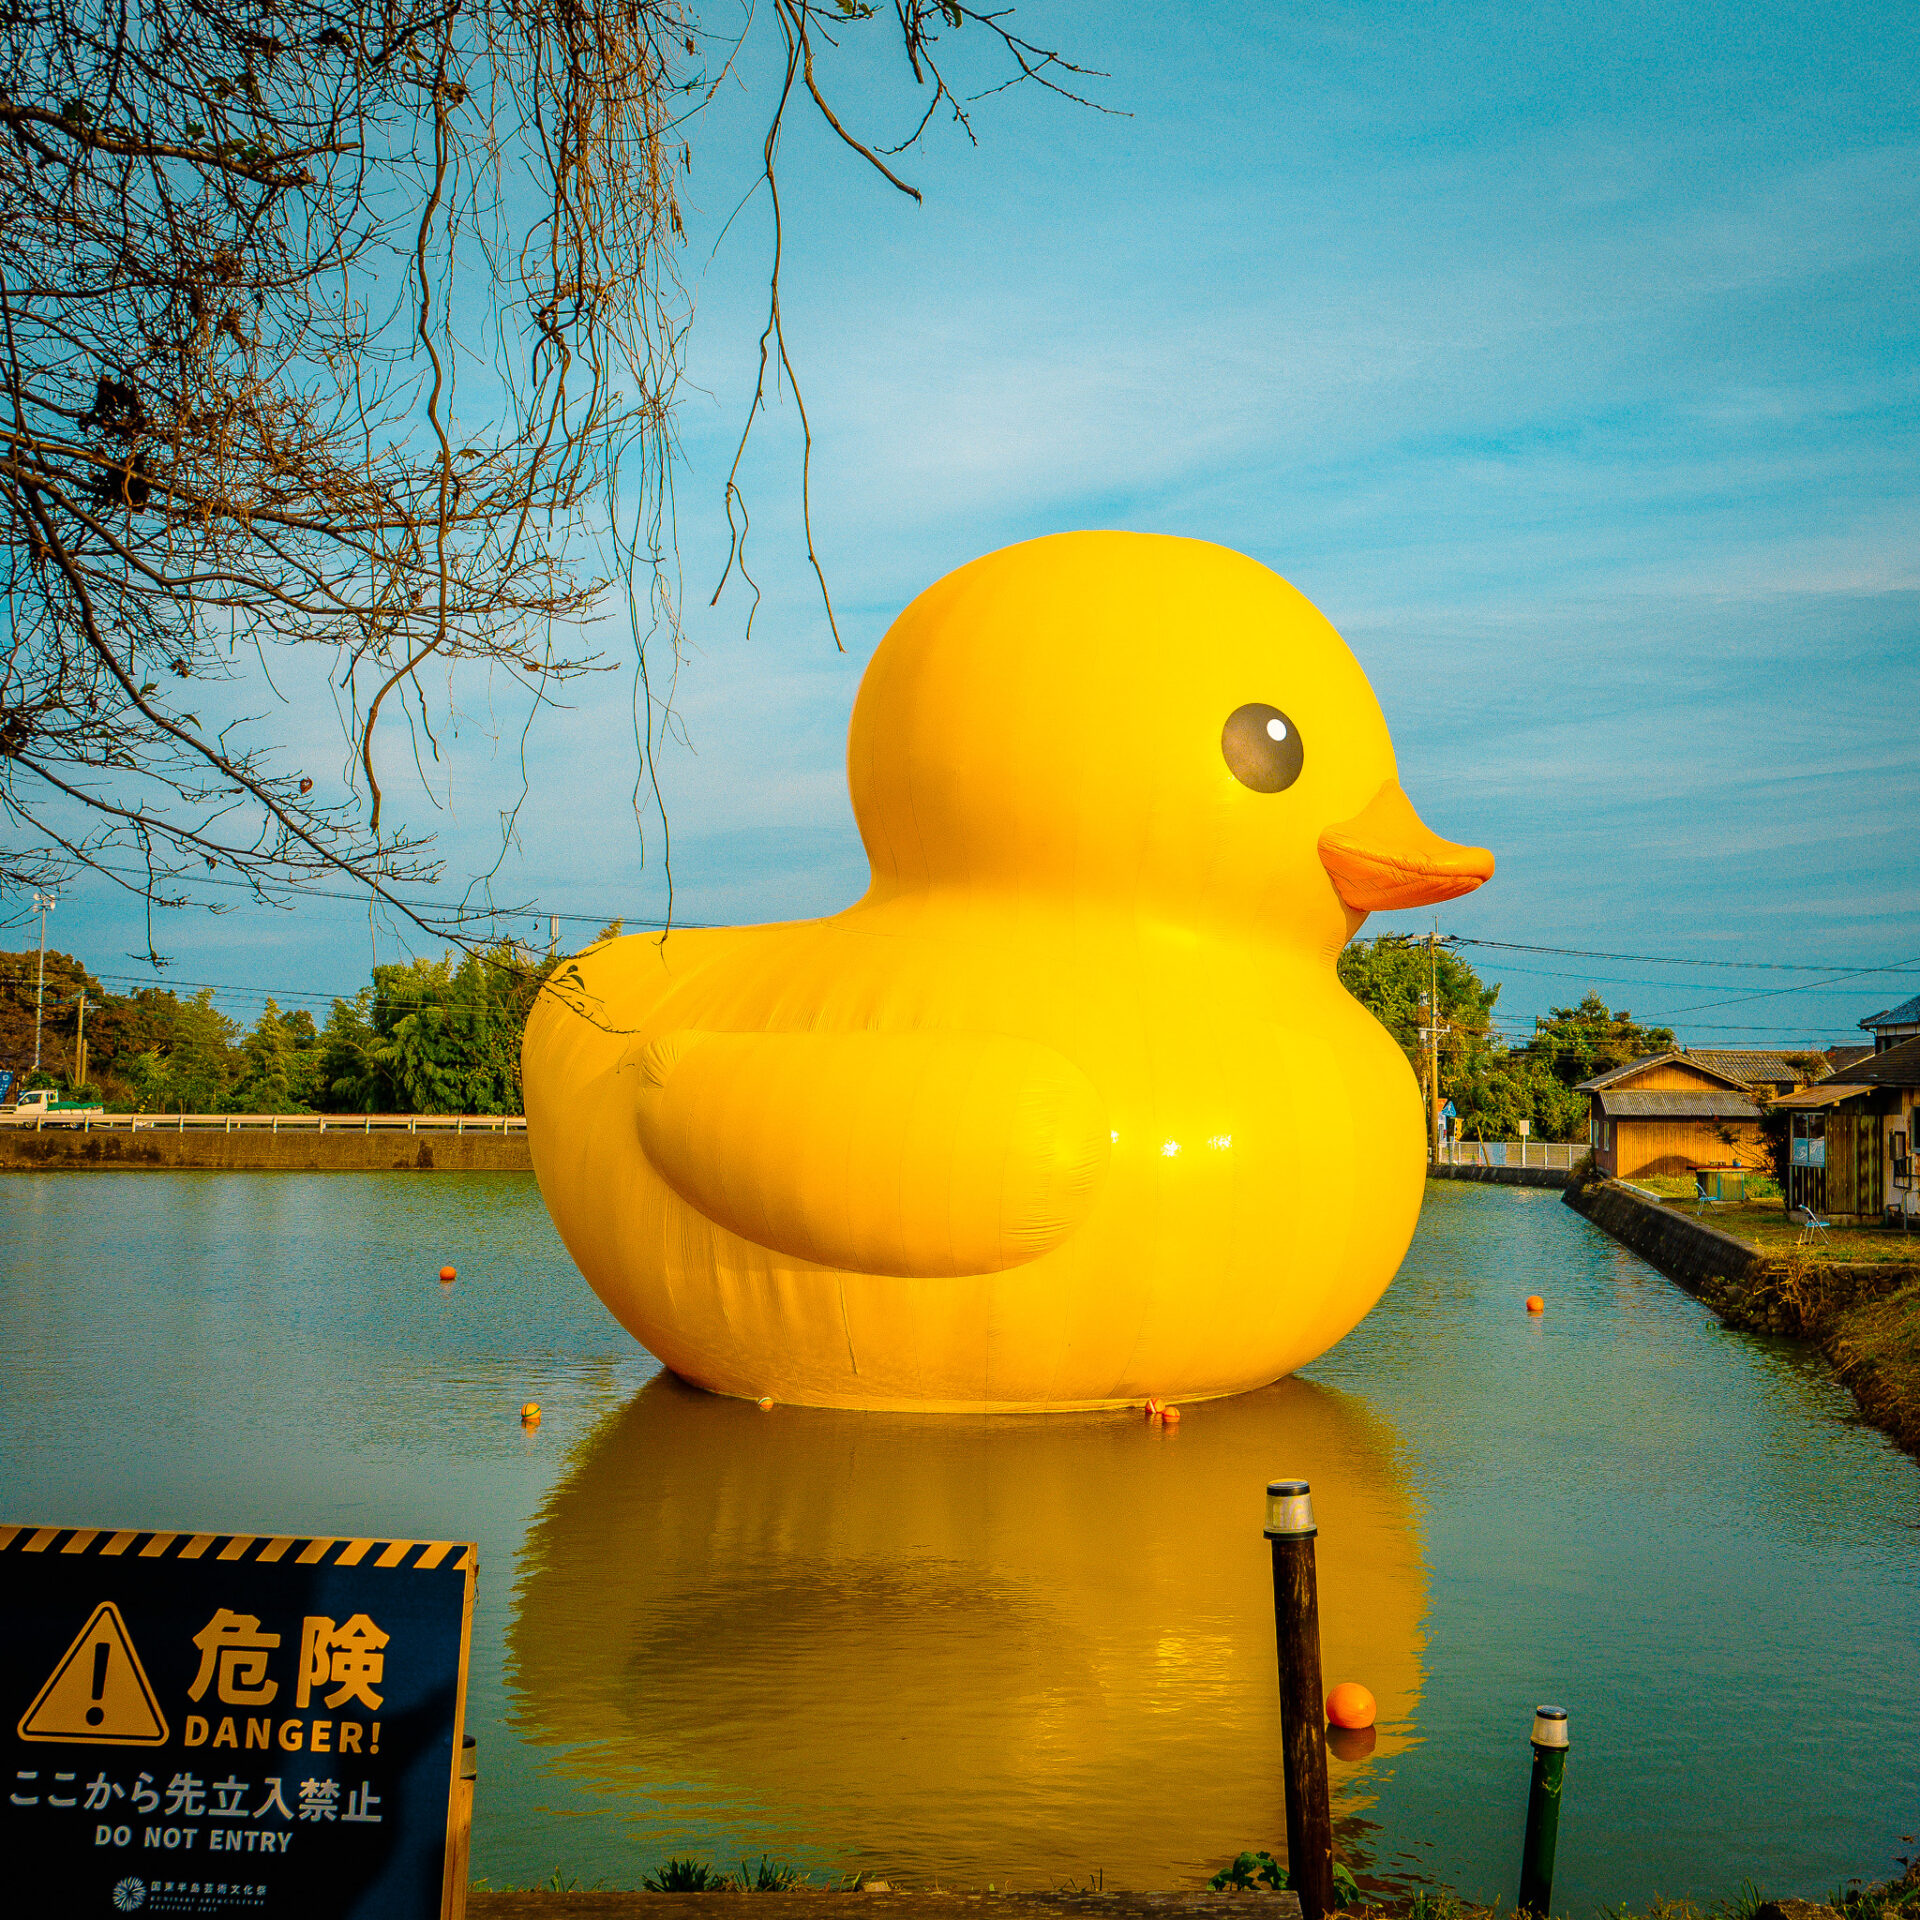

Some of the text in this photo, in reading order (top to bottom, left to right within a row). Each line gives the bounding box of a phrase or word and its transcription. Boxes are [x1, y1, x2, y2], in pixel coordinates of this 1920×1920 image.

[186, 1607, 391, 1711] 危険
[183, 1715, 382, 1755] DANGER!
[9, 1771, 383, 1823] ここから先立入禁止
[94, 1825, 293, 1853] DO NOT ENTRY
